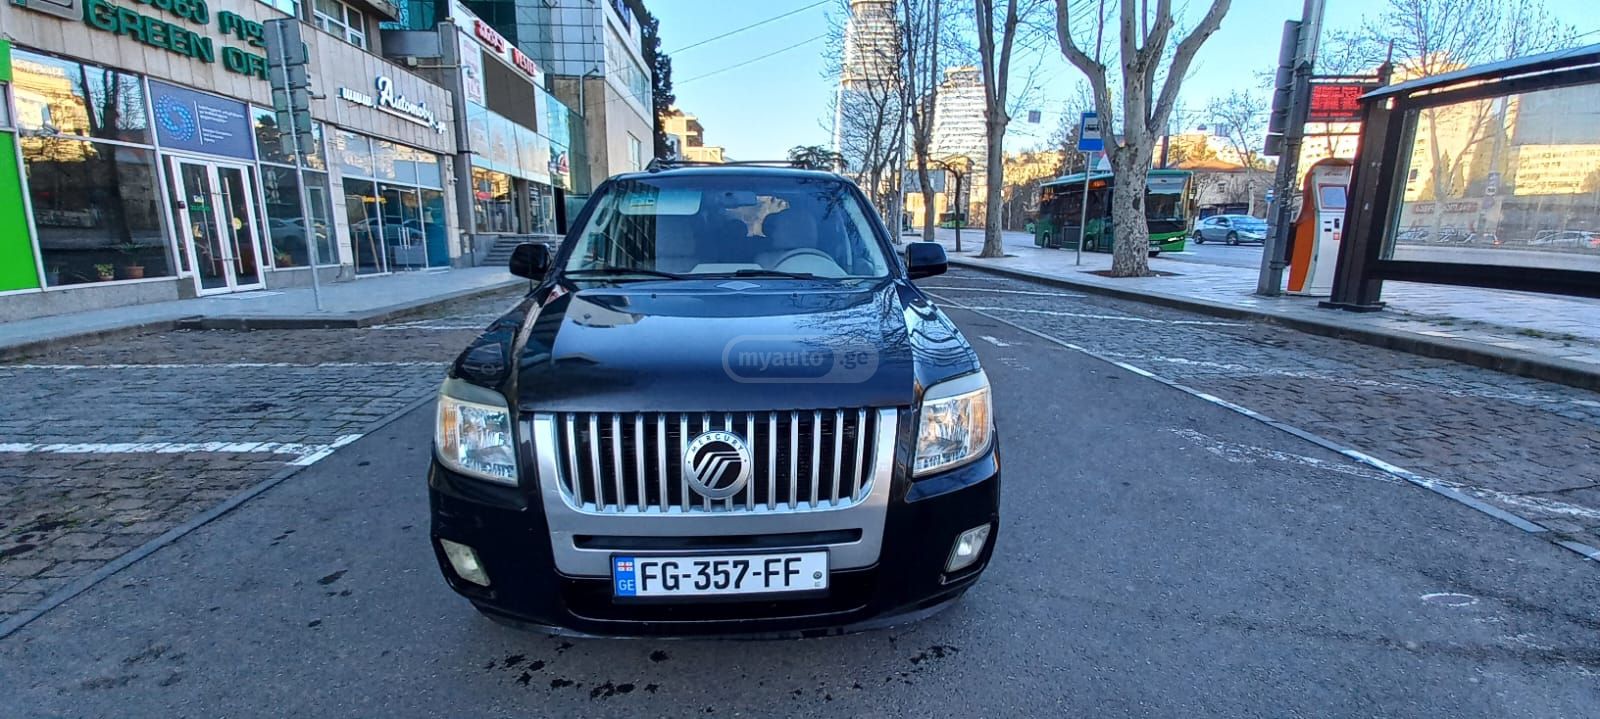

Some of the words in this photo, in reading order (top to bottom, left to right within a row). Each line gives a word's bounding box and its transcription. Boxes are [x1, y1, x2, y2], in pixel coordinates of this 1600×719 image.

[83, 0, 215, 63] GREEN
[691, 433, 744, 453] MERCURY
[618, 578, 635, 592] GE
[640, 557, 802, 592] FG-357-FF
